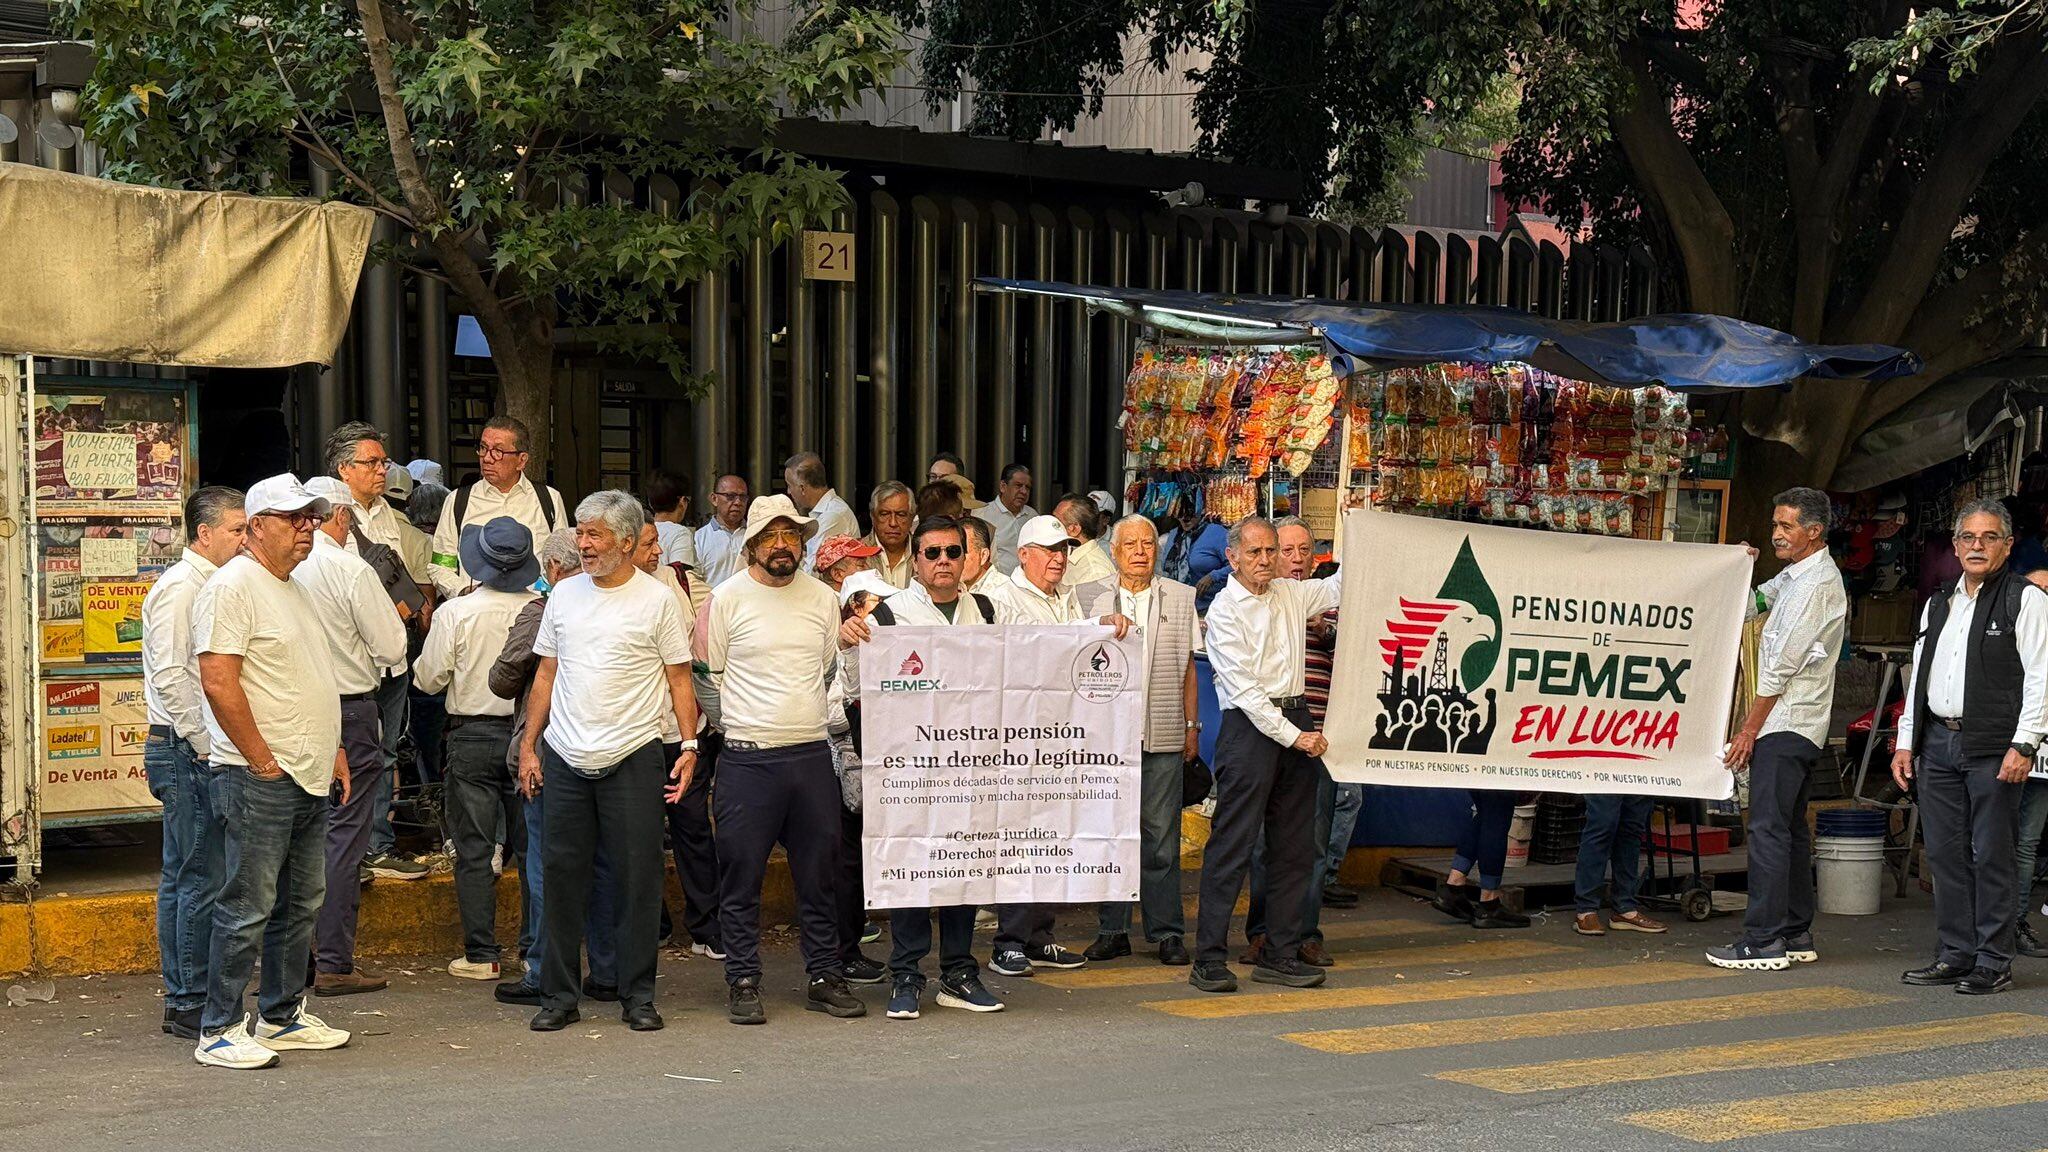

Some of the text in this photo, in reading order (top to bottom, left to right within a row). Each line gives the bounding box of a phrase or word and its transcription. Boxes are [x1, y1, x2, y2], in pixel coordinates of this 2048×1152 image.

[818, 242, 849, 270] 21
[67, 434, 88, 448] NO
[64, 454, 79, 469] LA
[86, 452, 134, 468] PUERTA
[70, 472, 136, 486] POR FAVOR
[88, 586, 105, 596] DE
[108, 586, 148, 596] VENTA
[88, 600, 120, 610] AQUI
[1512, 595, 1694, 630] PENSIONADOS
[1593, 633, 1611, 648] DE
[1505, 648, 1692, 704] PEMEX
[880, 679, 941, 692] PEMEX
[65, 706, 98, 714] TELMEX
[915, 722, 1086, 742] Nuestra pensión
[1511, 704, 1680, 752] EN LUCHA
[52, 731, 86, 743] Ladatel
[883, 748, 1126, 770] es un derecho legítimo.
[48, 766, 148, 783] De Venta Aq
[1366, 759, 1682, 787] POR NUESTRAS PENSIONES POR NUESTROS DERECHOS POR NUESTRO FUTURO
[882, 774, 1120, 790] Cumplimos décadas de servicio en Pemex
[880, 789, 1122, 806] con compromiso y mucha responsabilidad.
[945, 827, 1058, 842] #Certeza jurídica
[929, 845, 1074, 861] #Derechos adquiridos
[881, 868, 906, 881] #Mi
[910, 866, 965, 882] pensión
[968, 868, 983, 878] es
[1034, 865, 1052, 875] no
[1055, 864, 1070, 874] es
[1073, 862, 1122, 874] dorada
